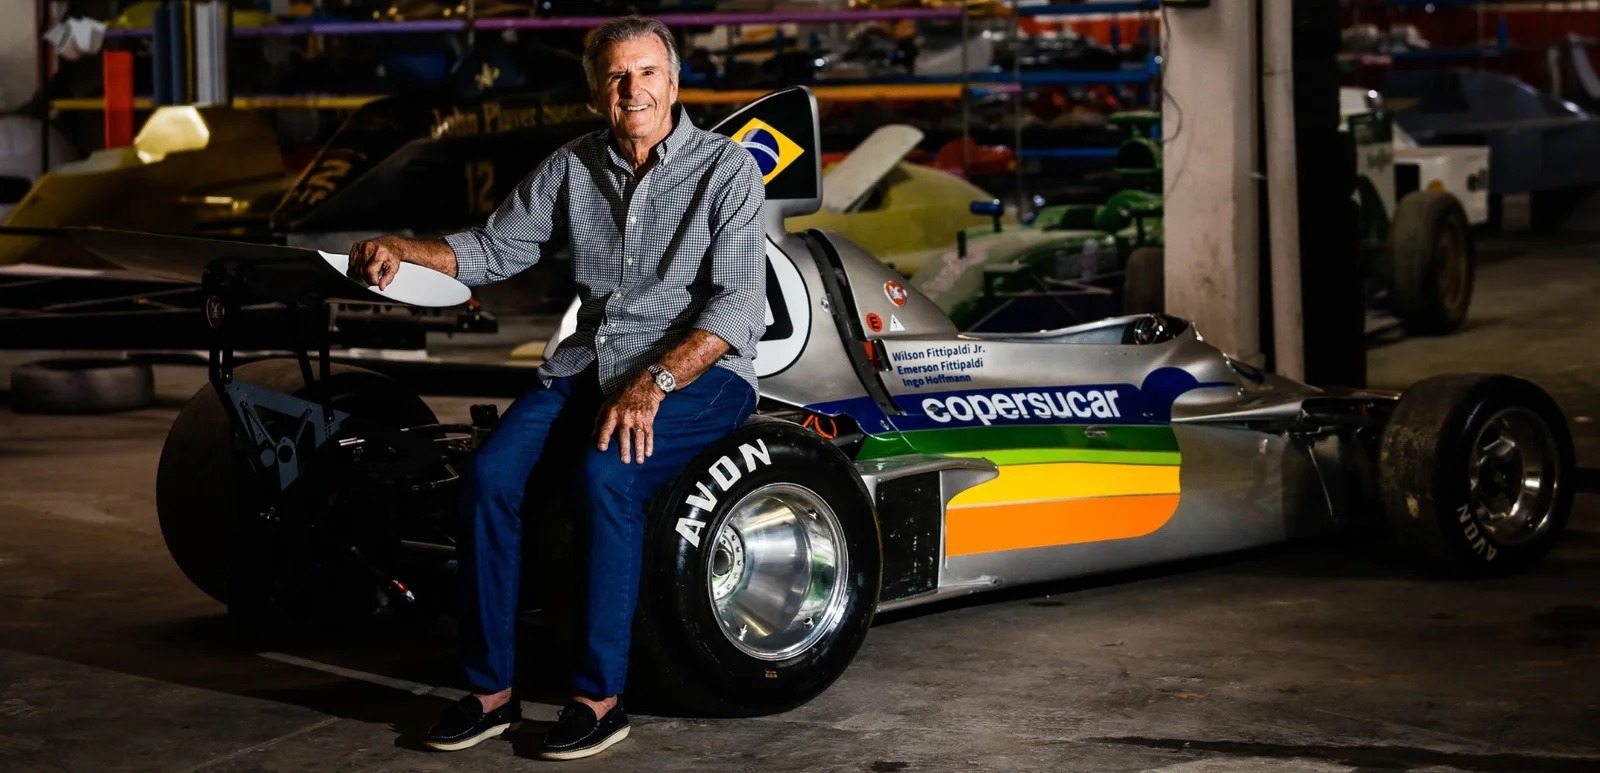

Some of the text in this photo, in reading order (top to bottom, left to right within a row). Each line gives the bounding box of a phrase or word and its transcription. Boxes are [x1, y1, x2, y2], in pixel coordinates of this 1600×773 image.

[430, 106, 479, 140] John
[482, 101, 538, 133] Player
[464, 160, 497, 216] 12
[869, 316, 880, 330] E
[892, 343, 986, 362] Wilson Fittipaldi Jr.
[897, 359, 984, 375] Emerson Fittipaldi
[902, 374, 972, 388] Ingo Hoffmann
[921, 389, 1121, 426] copersucar
[675, 438, 772, 548] AVON
[1455, 503, 1498, 562] AVON
